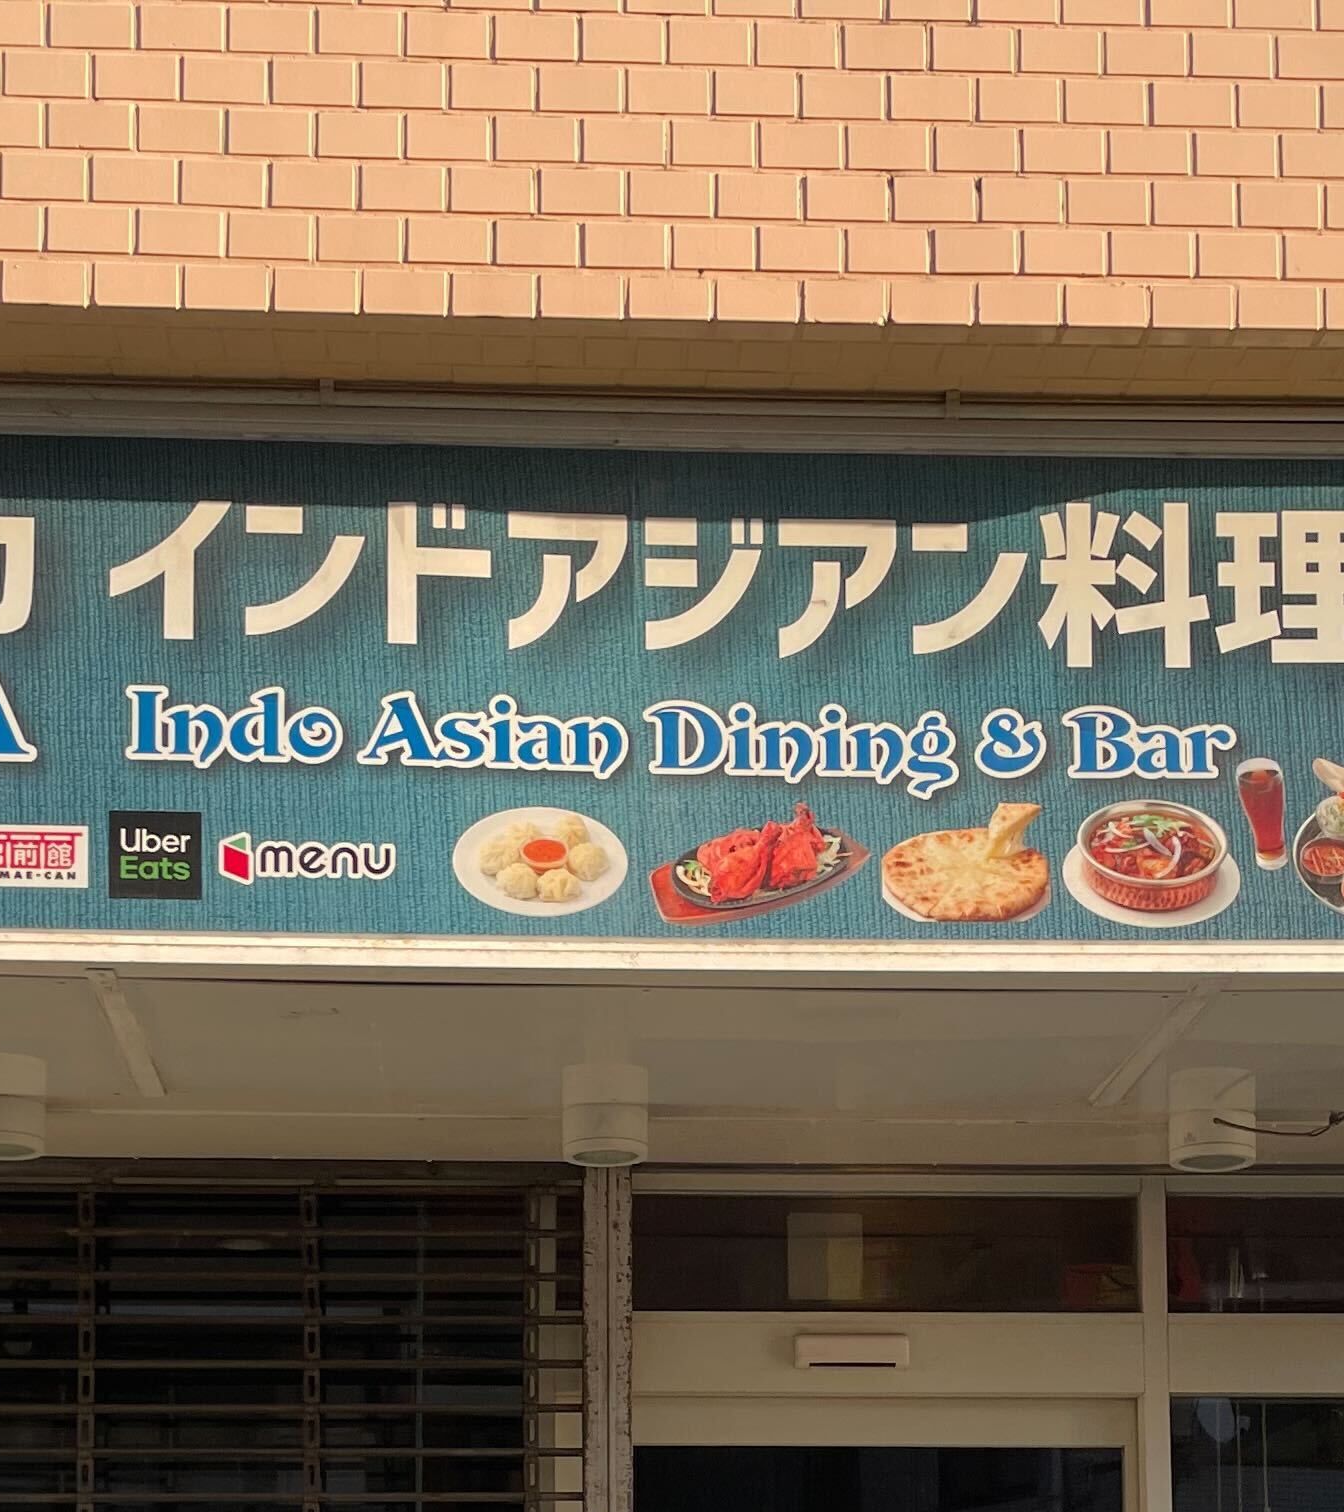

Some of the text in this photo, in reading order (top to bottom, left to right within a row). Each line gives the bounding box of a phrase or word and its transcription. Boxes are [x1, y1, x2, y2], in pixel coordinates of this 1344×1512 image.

[126, 684, 1235, 800] Indo Asian Dining & Bar
[119, 828, 191, 853] Uber
[119, 855, 191, 881] Eats
[258, 842, 396, 880] menu
